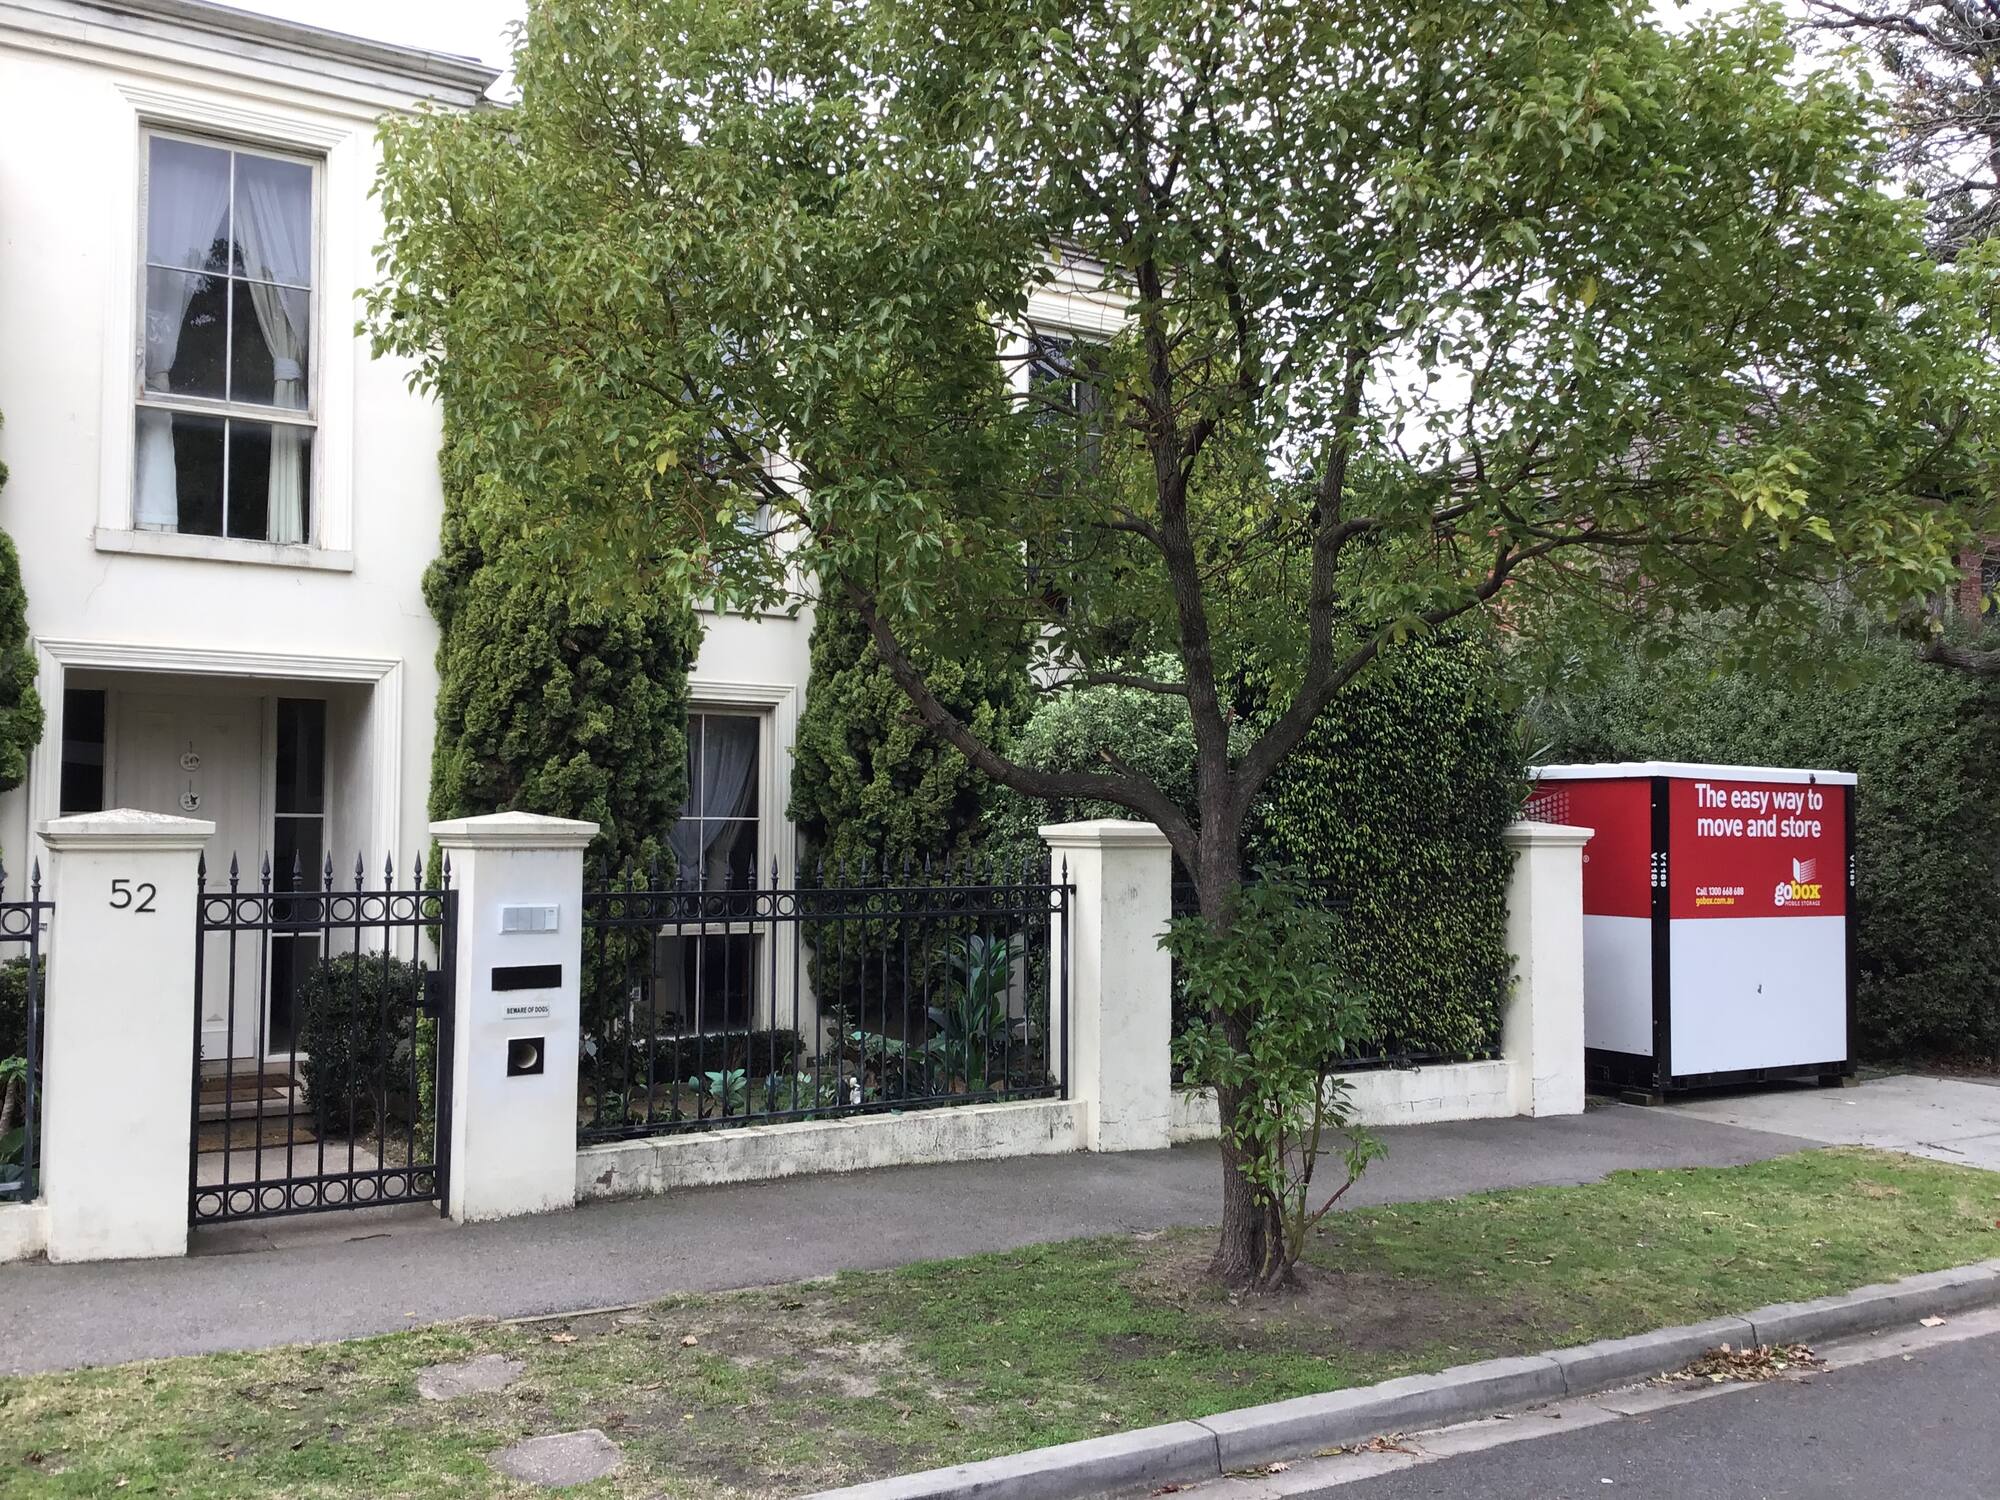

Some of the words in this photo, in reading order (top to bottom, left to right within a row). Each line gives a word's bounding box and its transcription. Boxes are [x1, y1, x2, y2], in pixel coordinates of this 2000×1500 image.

[1695, 783, 1727, 808] The
[1731, 790, 1769, 815] easy
[1771, 791, 1804, 816] way
[1808, 789, 1823, 811] to
[1697, 817, 1743, 837] move
[1747, 814, 1777, 837] and
[1780, 816, 1822, 838] store
[1650, 852, 1658, 887] V1189
[109, 878, 157, 913] 52
[1696, 886, 1708, 896] Call
[1708, 886, 1722, 896] 1300
[1696, 896, 1734, 907] gobox.com.au
[1774, 880, 1821, 907] gobox
